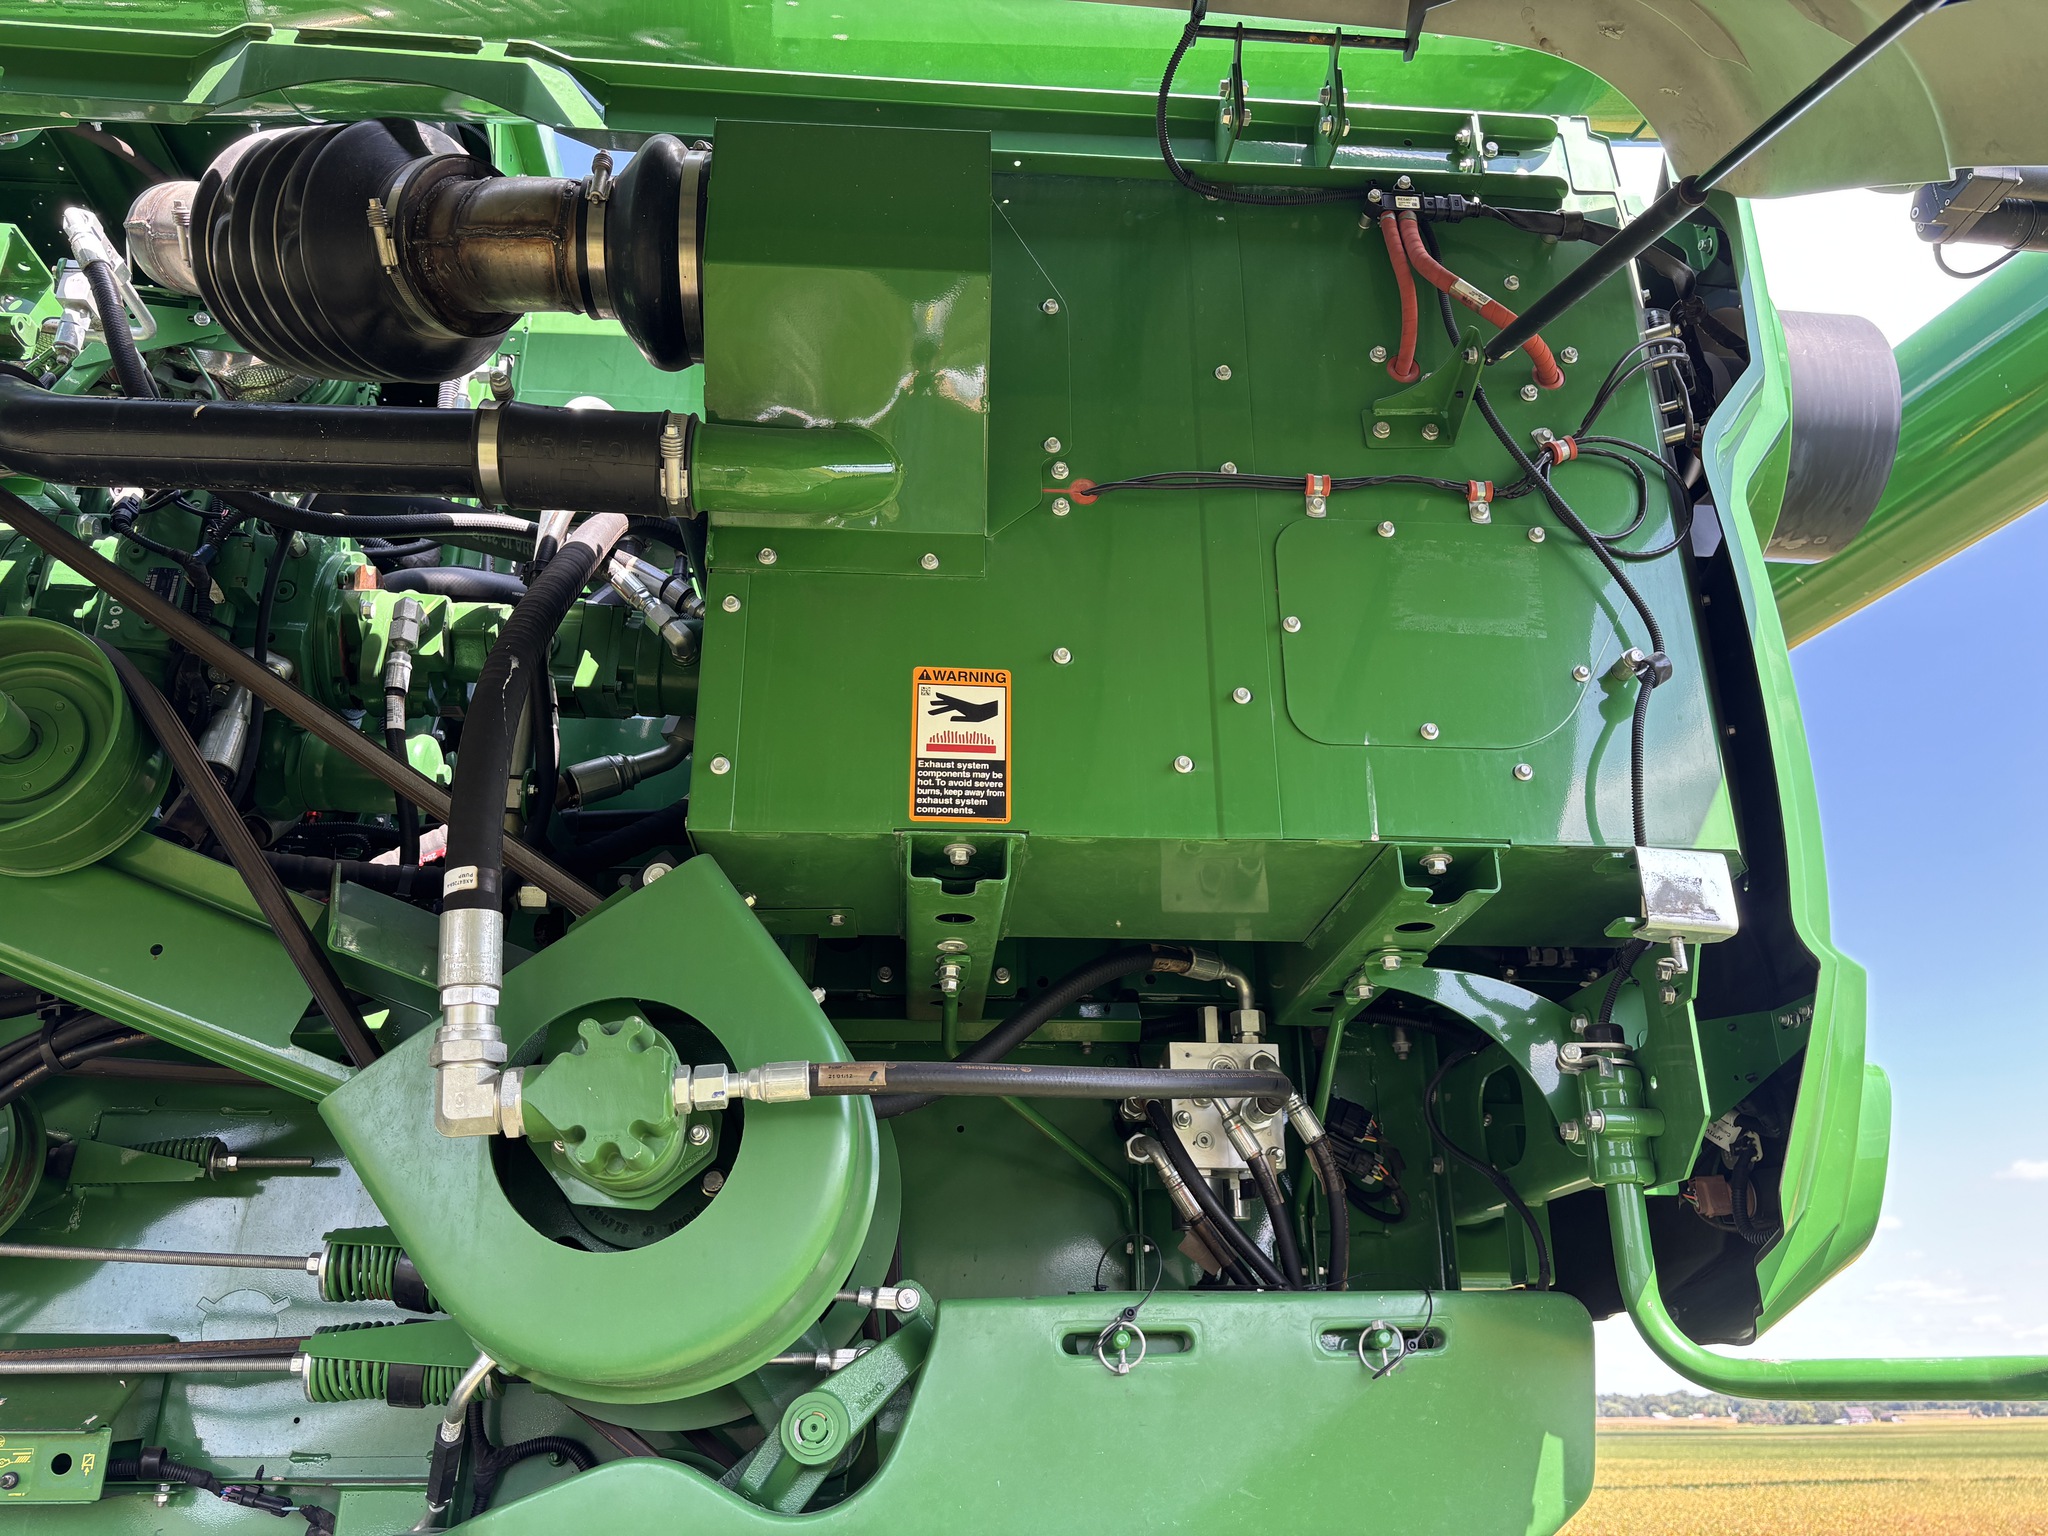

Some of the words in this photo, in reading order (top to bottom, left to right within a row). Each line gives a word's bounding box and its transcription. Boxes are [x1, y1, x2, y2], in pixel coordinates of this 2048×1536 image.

[933, 670, 1007, 684] WARNING
[918, 760, 955, 769] Exhaust
[957, 762, 989, 770] system
[918, 770, 971, 779] components
[973, 772, 991, 780] may
[992, 771, 1003, 779] be
[918, 778, 935, 787] hot.
[948, 779, 972, 787] avoid
[917, 788, 943, 796] burns,
[943, 788, 963, 797] keep
[986, 789, 1005, 797] from
[916, 796, 953, 805] exhaust
[955, 798, 988, 807] system
[916, 806, 976, 815] components.
